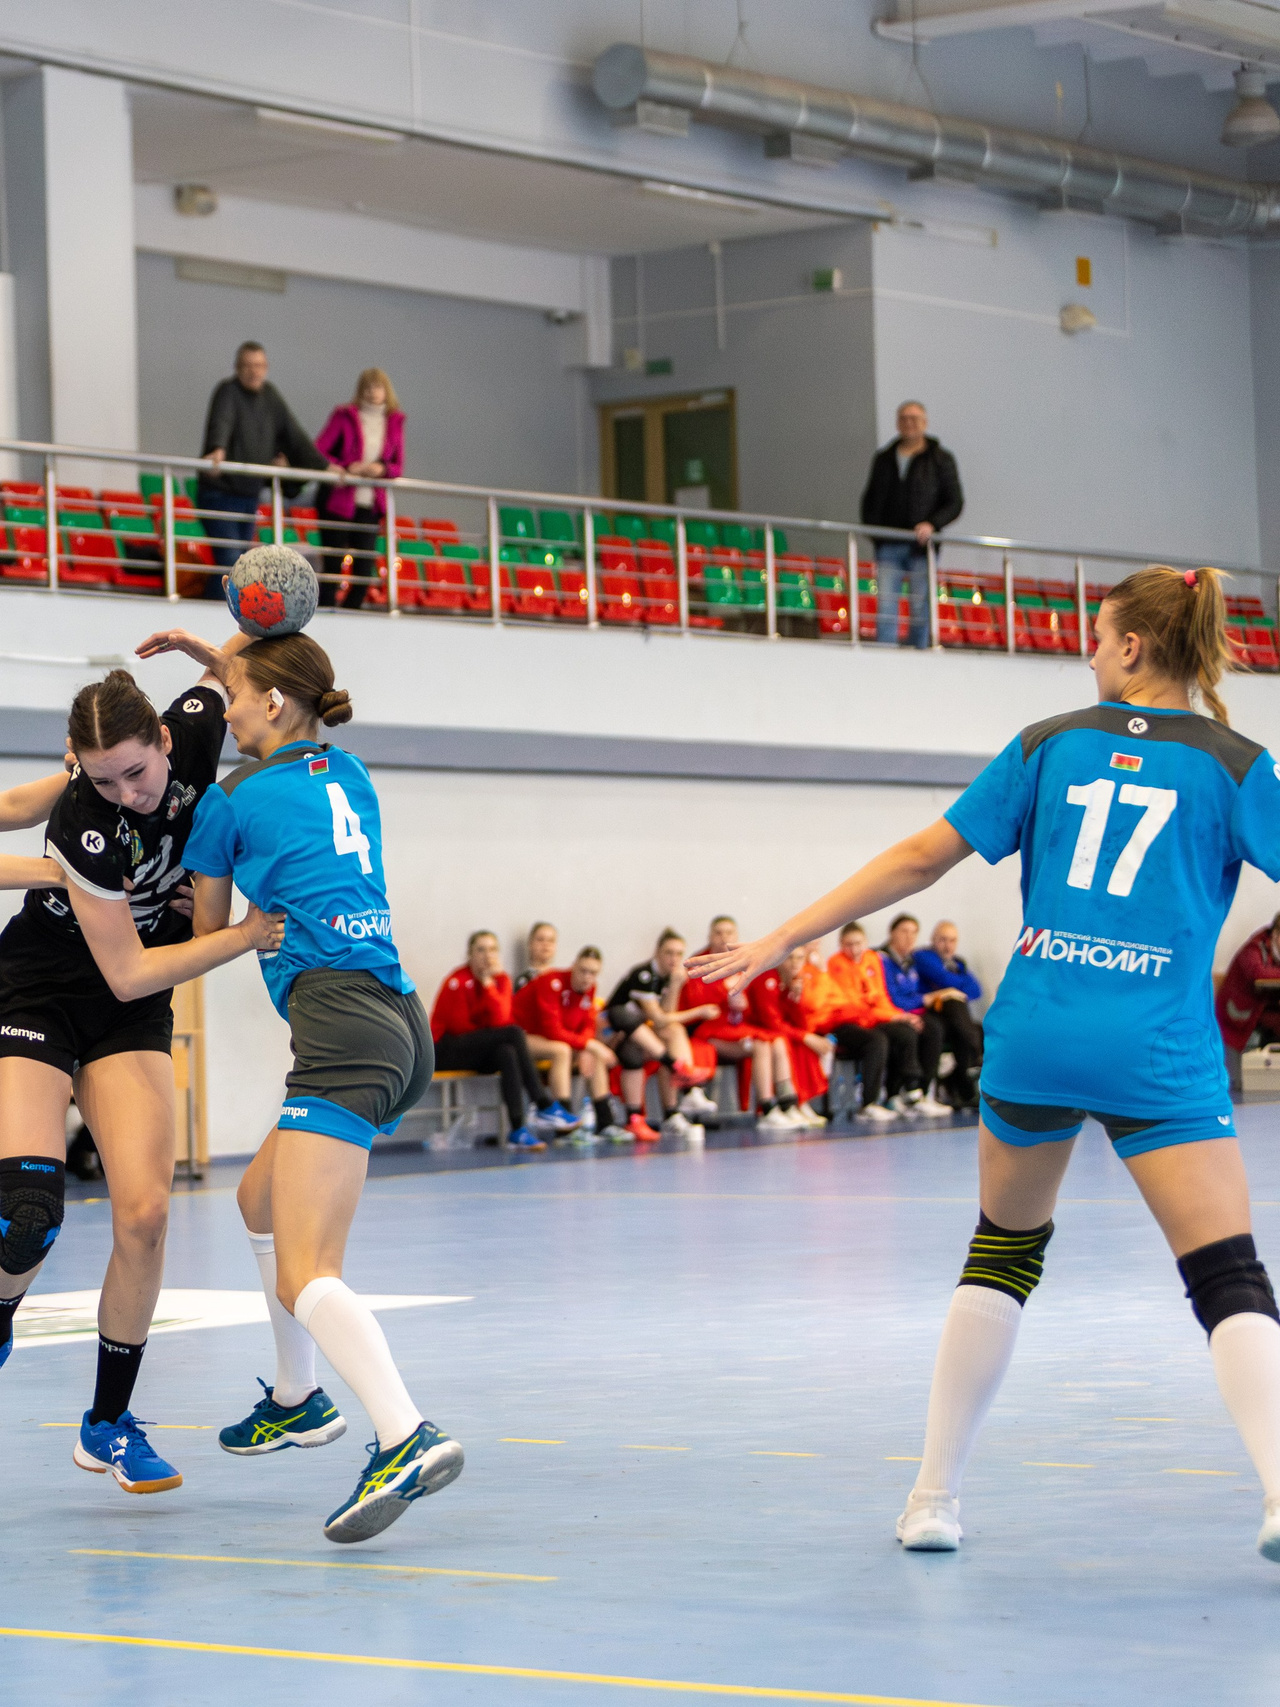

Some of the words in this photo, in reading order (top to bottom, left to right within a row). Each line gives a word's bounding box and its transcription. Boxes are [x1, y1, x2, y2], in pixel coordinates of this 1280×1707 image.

[325, 782, 373, 875] 4
[1066, 778, 1177, 897] 17
[1, 1025, 45, 1041] Kempa
[281, 1106, 308, 1119] empa
[21, 1161, 56, 1174] Kempa
